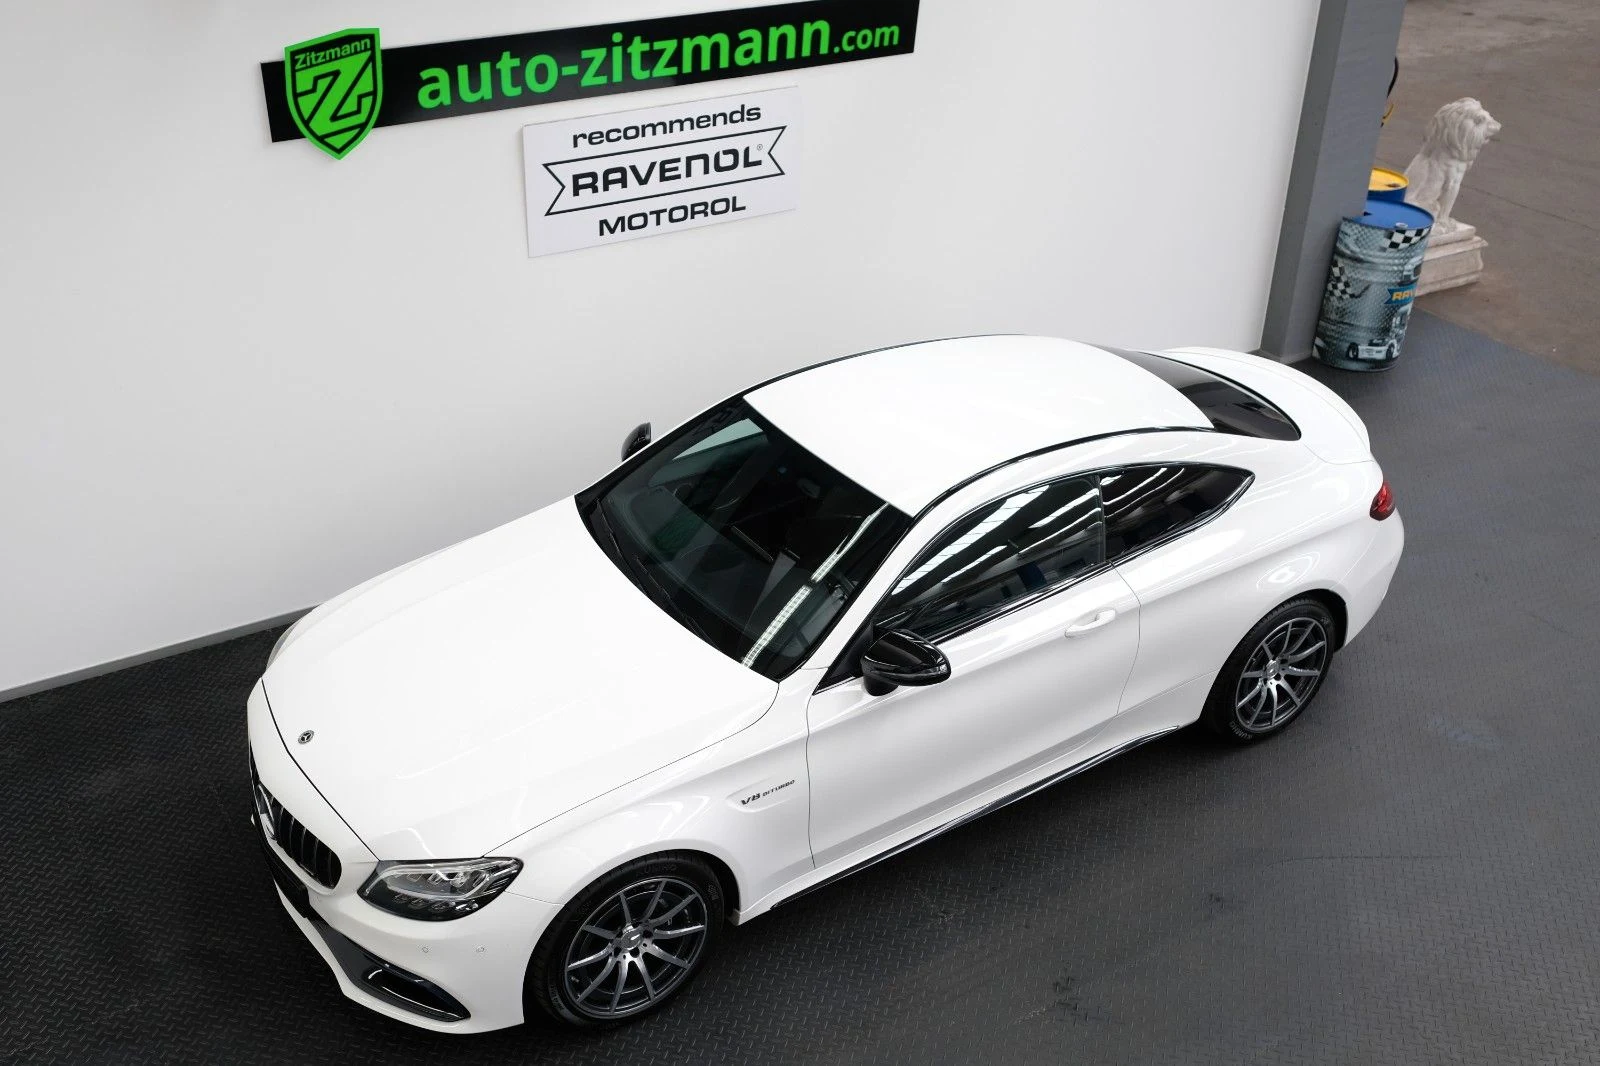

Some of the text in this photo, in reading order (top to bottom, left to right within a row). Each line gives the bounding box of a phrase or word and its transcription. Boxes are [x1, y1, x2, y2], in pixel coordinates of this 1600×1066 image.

[294, 38, 371, 70] Zitzmann
[417, 19, 900, 109] auto-zitzmann.com
[572, 104, 762, 148] recommends
[571, 146, 763, 198] RAVENOL
[598, 195, 747, 237] MOTOROL
[740, 793, 761, 805] V8
